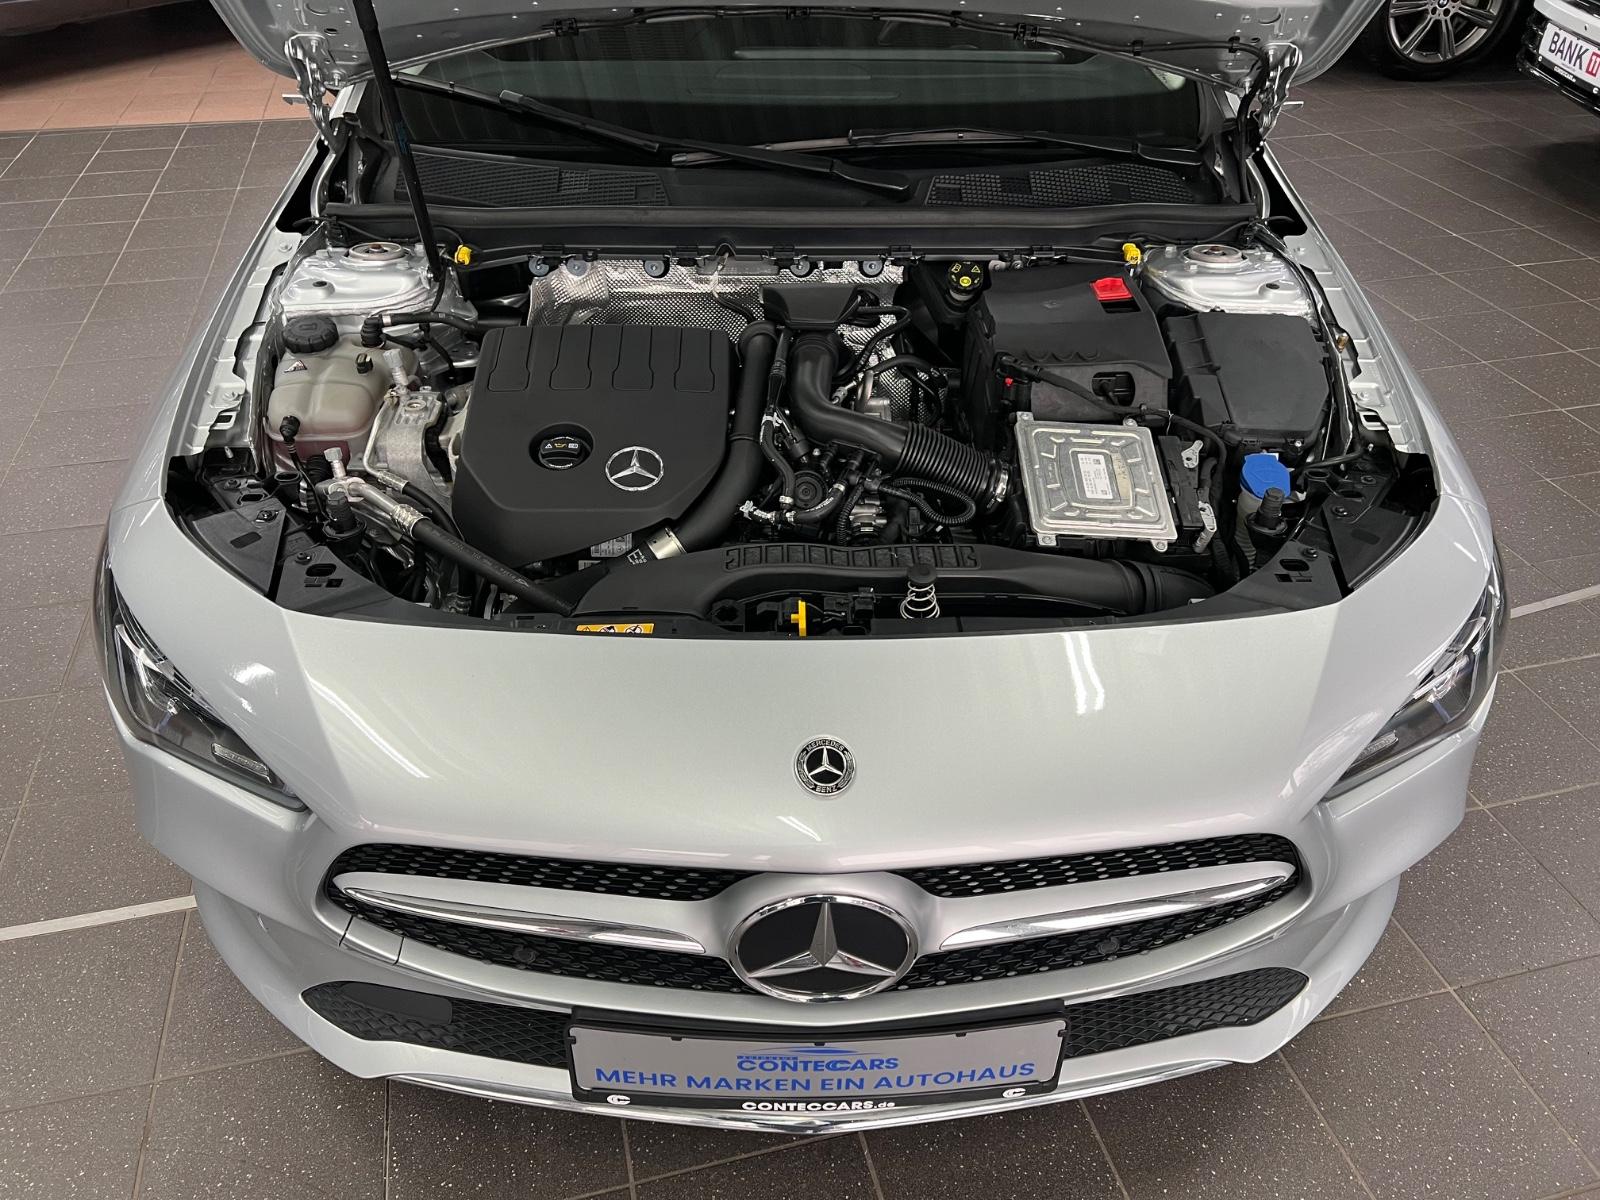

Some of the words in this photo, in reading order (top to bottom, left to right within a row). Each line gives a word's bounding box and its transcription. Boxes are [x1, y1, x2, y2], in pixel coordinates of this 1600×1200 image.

[1548, 31, 1589, 70] BANK
[805, 739, 845, 751] MERCEDES
[815, 785, 838, 793] BENZ
[595, 1068, 677, 1088] MEHR
[687, 1075, 811, 1092] MARKEN
[820, 1077, 865, 1091] EIN
[874, 1062, 1035, 1089] AUTOHAUS
[742, 1100, 896, 1112] CONTECCARS.de
